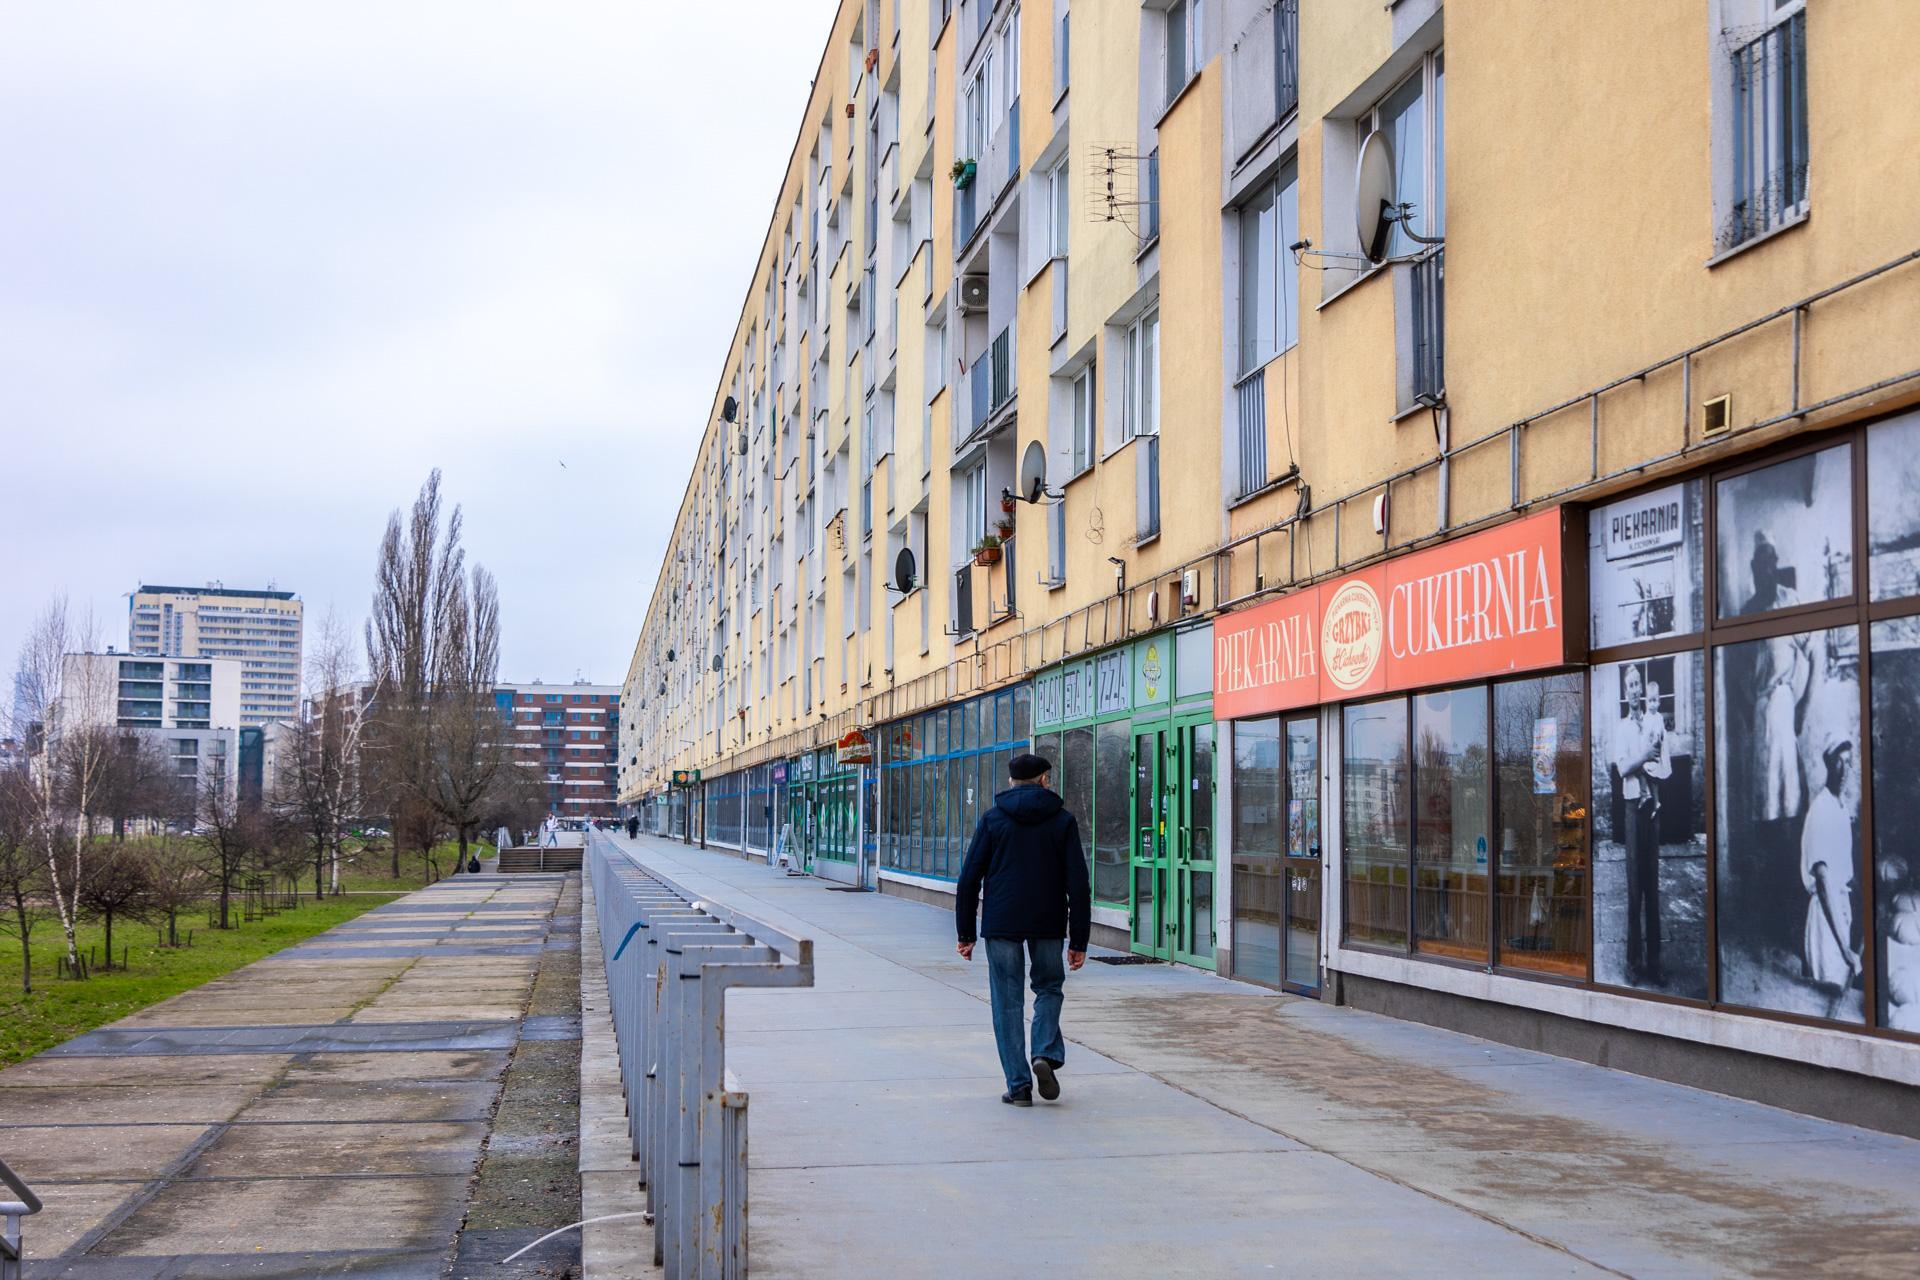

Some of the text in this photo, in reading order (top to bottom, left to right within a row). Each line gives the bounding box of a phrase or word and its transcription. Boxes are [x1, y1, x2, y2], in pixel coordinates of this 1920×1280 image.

[1613, 503, 1678, 544] PIEKARNIA
[1388, 545, 1557, 659] CUKIERNIA
[1037, 669, 1081, 723] PLANETA
[1083, 650, 1129, 717] PIZZA
[1216, 614, 1316, 694] PIEKARNIA
